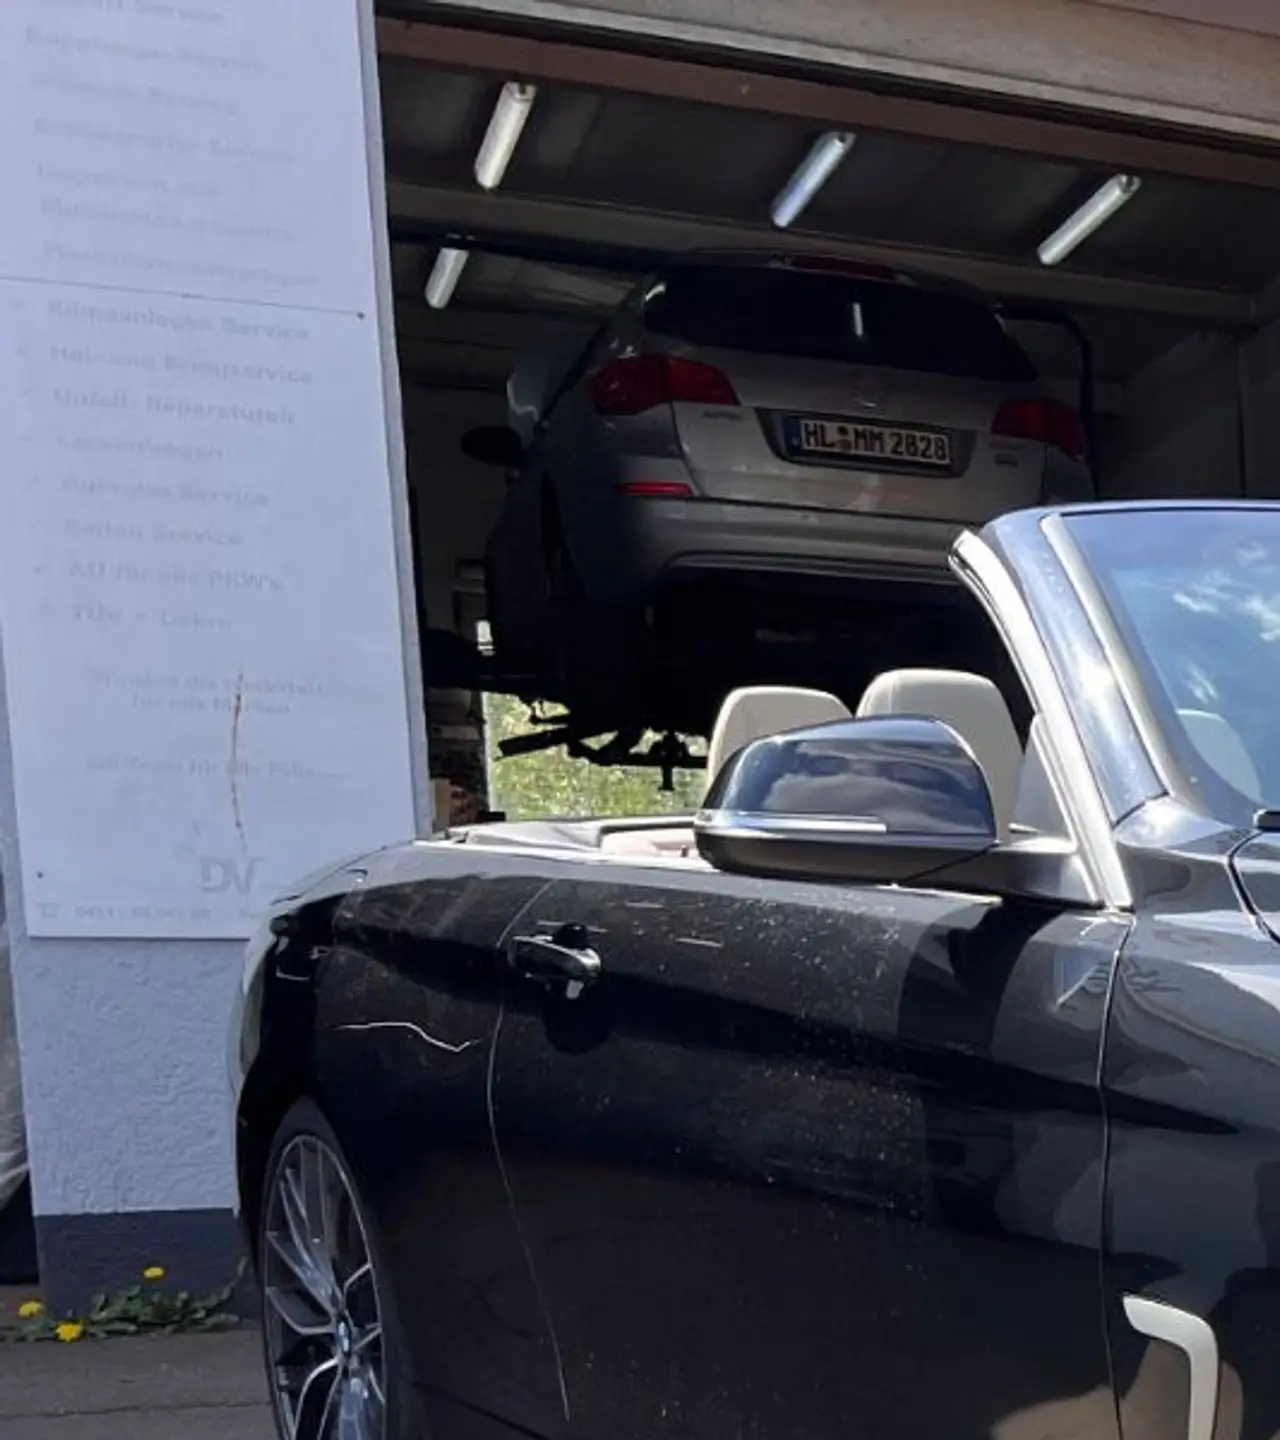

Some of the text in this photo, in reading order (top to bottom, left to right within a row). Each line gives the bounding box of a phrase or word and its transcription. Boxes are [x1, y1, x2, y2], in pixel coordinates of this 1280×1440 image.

[803, 422, 948, 461] HL MM 2828
[201, 855, 265, 894] DV
